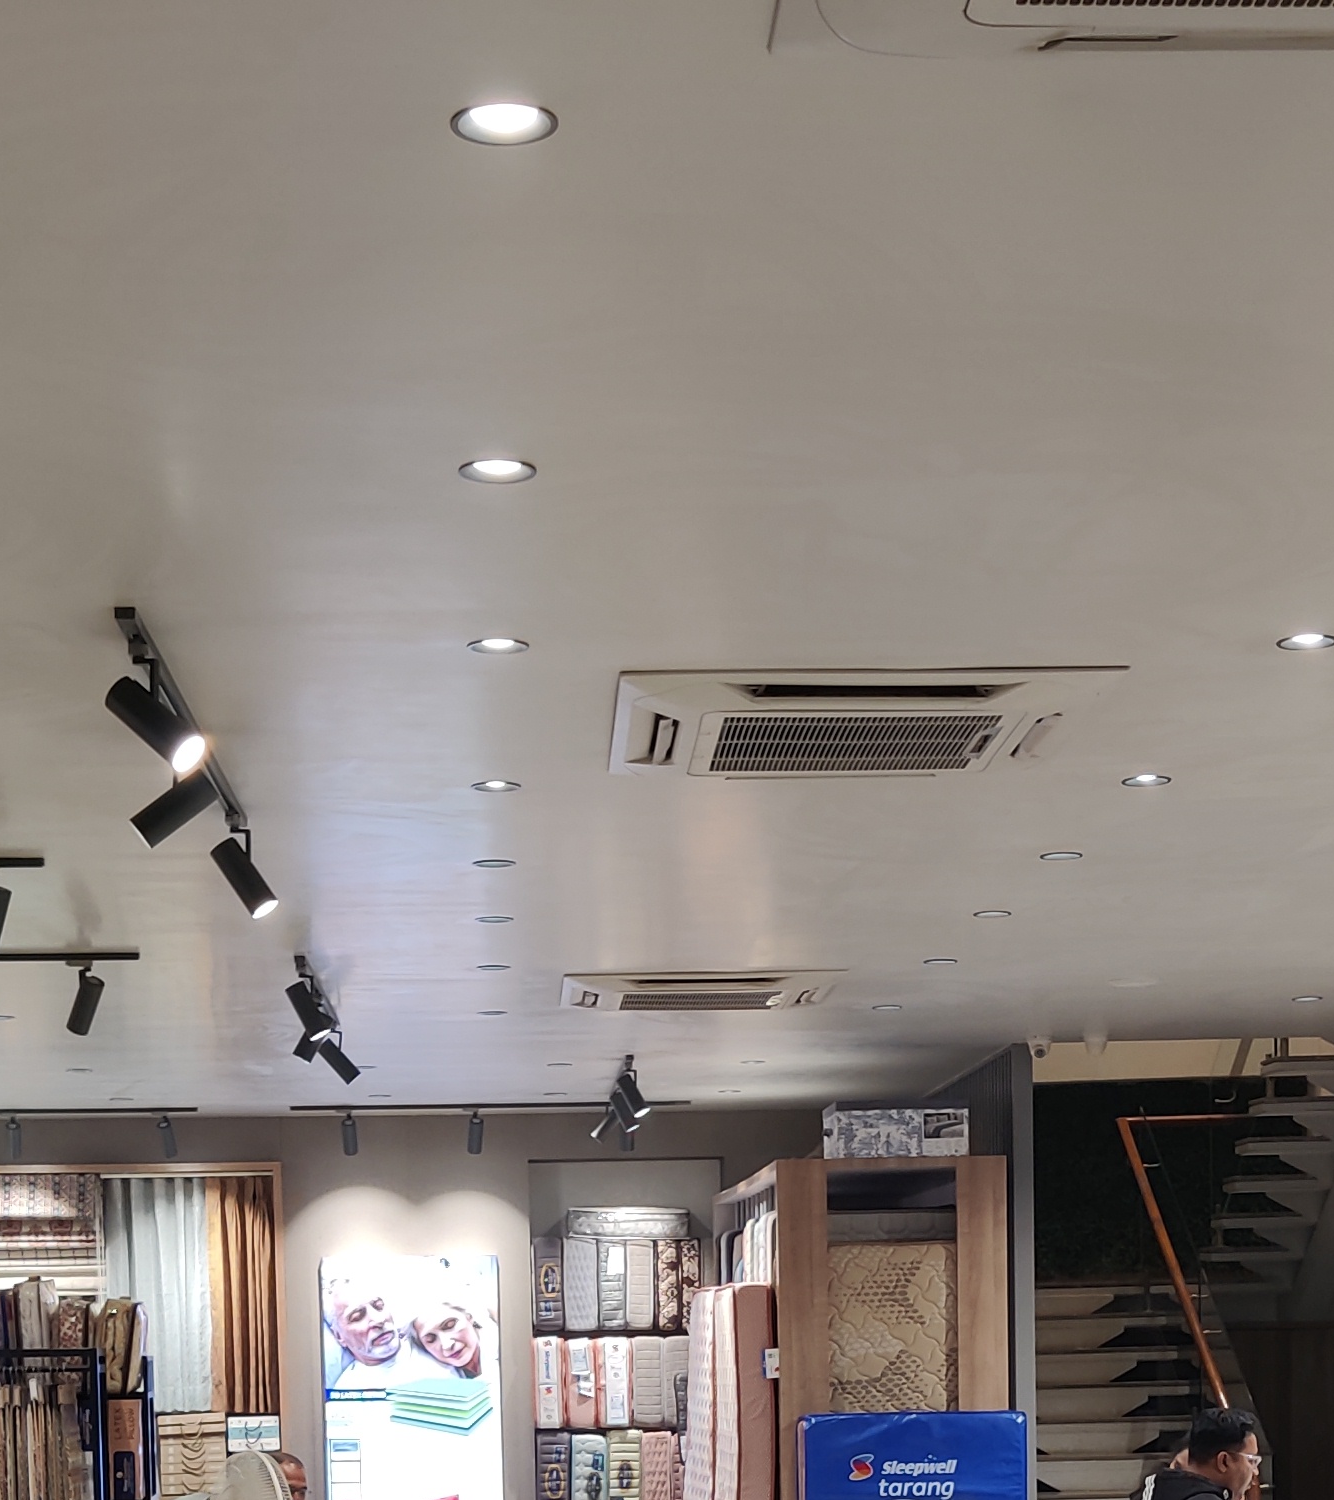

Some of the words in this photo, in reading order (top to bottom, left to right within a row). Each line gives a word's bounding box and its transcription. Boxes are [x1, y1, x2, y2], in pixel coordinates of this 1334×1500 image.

[127, 1407, 135, 1440] PILLOW
[881, 1459, 958, 1477] Sleepwell
[878, 1478, 955, 1500] tarang
